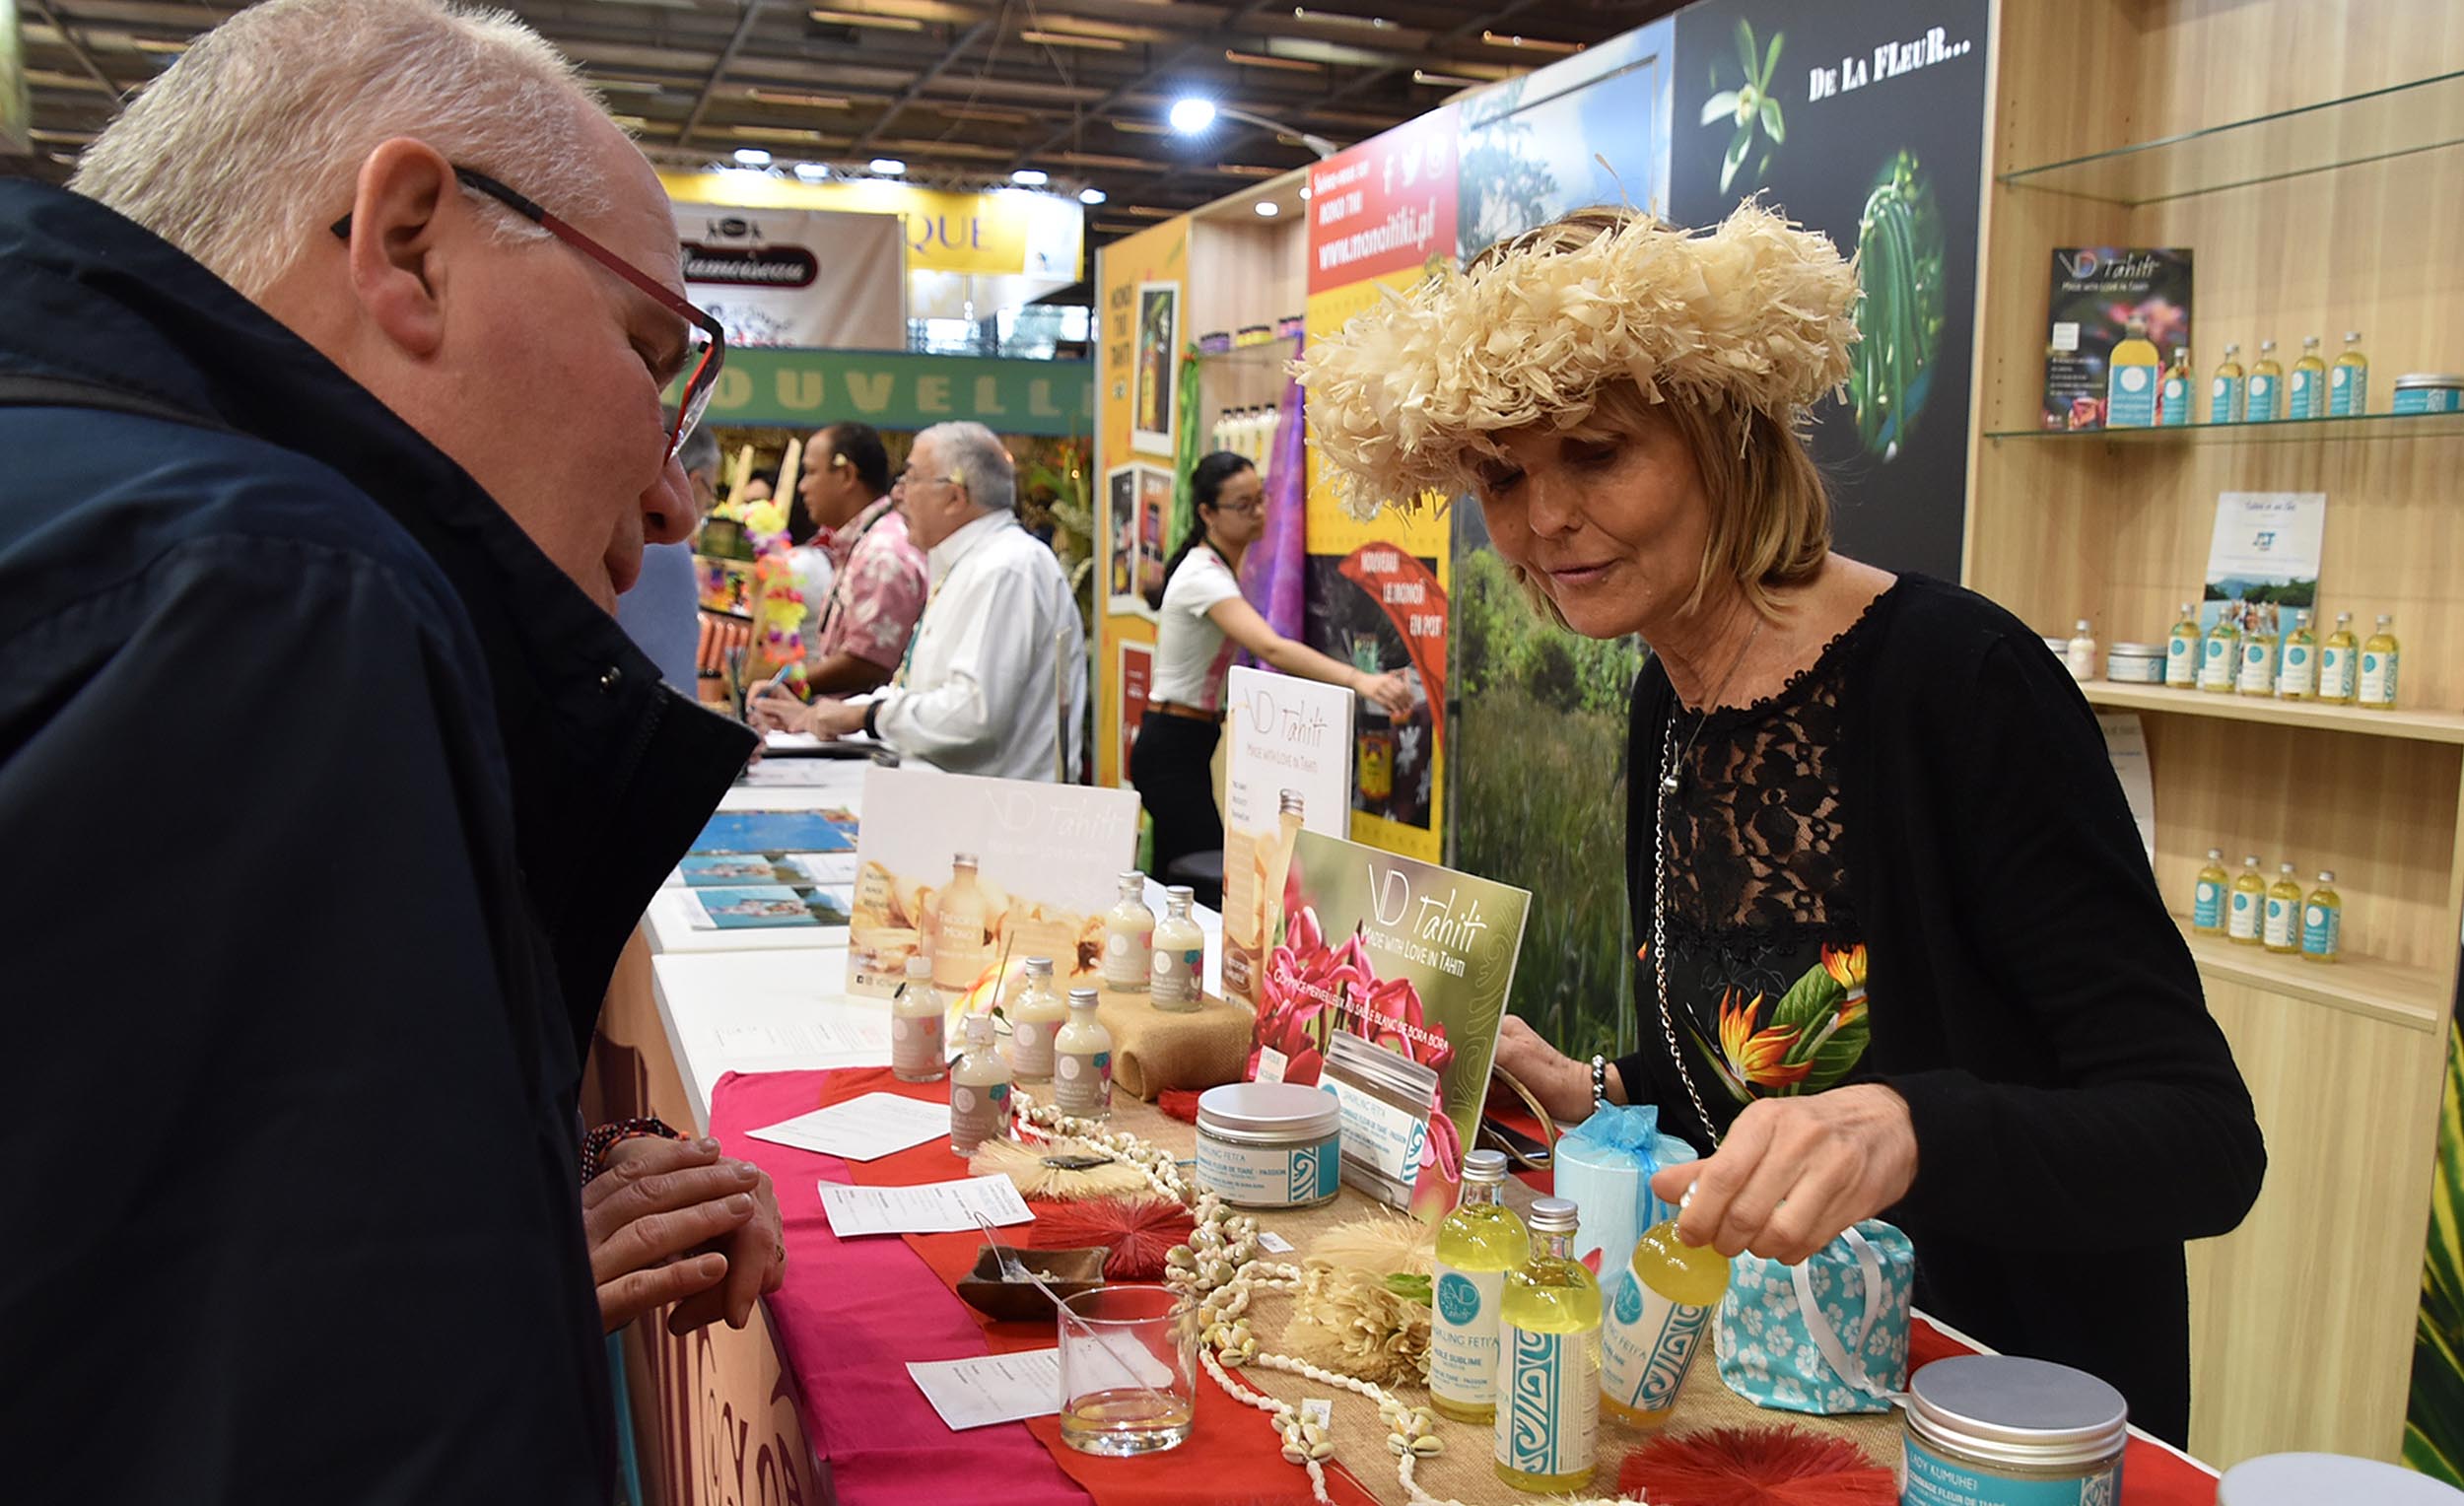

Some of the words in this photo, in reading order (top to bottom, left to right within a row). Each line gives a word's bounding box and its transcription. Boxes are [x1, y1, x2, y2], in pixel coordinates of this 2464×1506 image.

[658, 367, 1093, 418] OUVELL
[1280, 699, 1329, 749] Tahiti
[1367, 863, 1410, 927] VD
[1412, 888, 1488, 954] Tahiti
[1362, 924, 1385, 948] MADE
[1384, 934, 1404, 954] WITH
[1403, 939, 1428, 964] LOVE
[1427, 951, 1439, 967] IN
[1439, 950, 1467, 979] TAHITI
[1374, 1011, 1398, 1032] BLANC
[1397, 1021, 1407, 1033] DE
[1407, 1024, 1428, 1045] BORA
[1427, 1033, 1449, 1053] BORA
